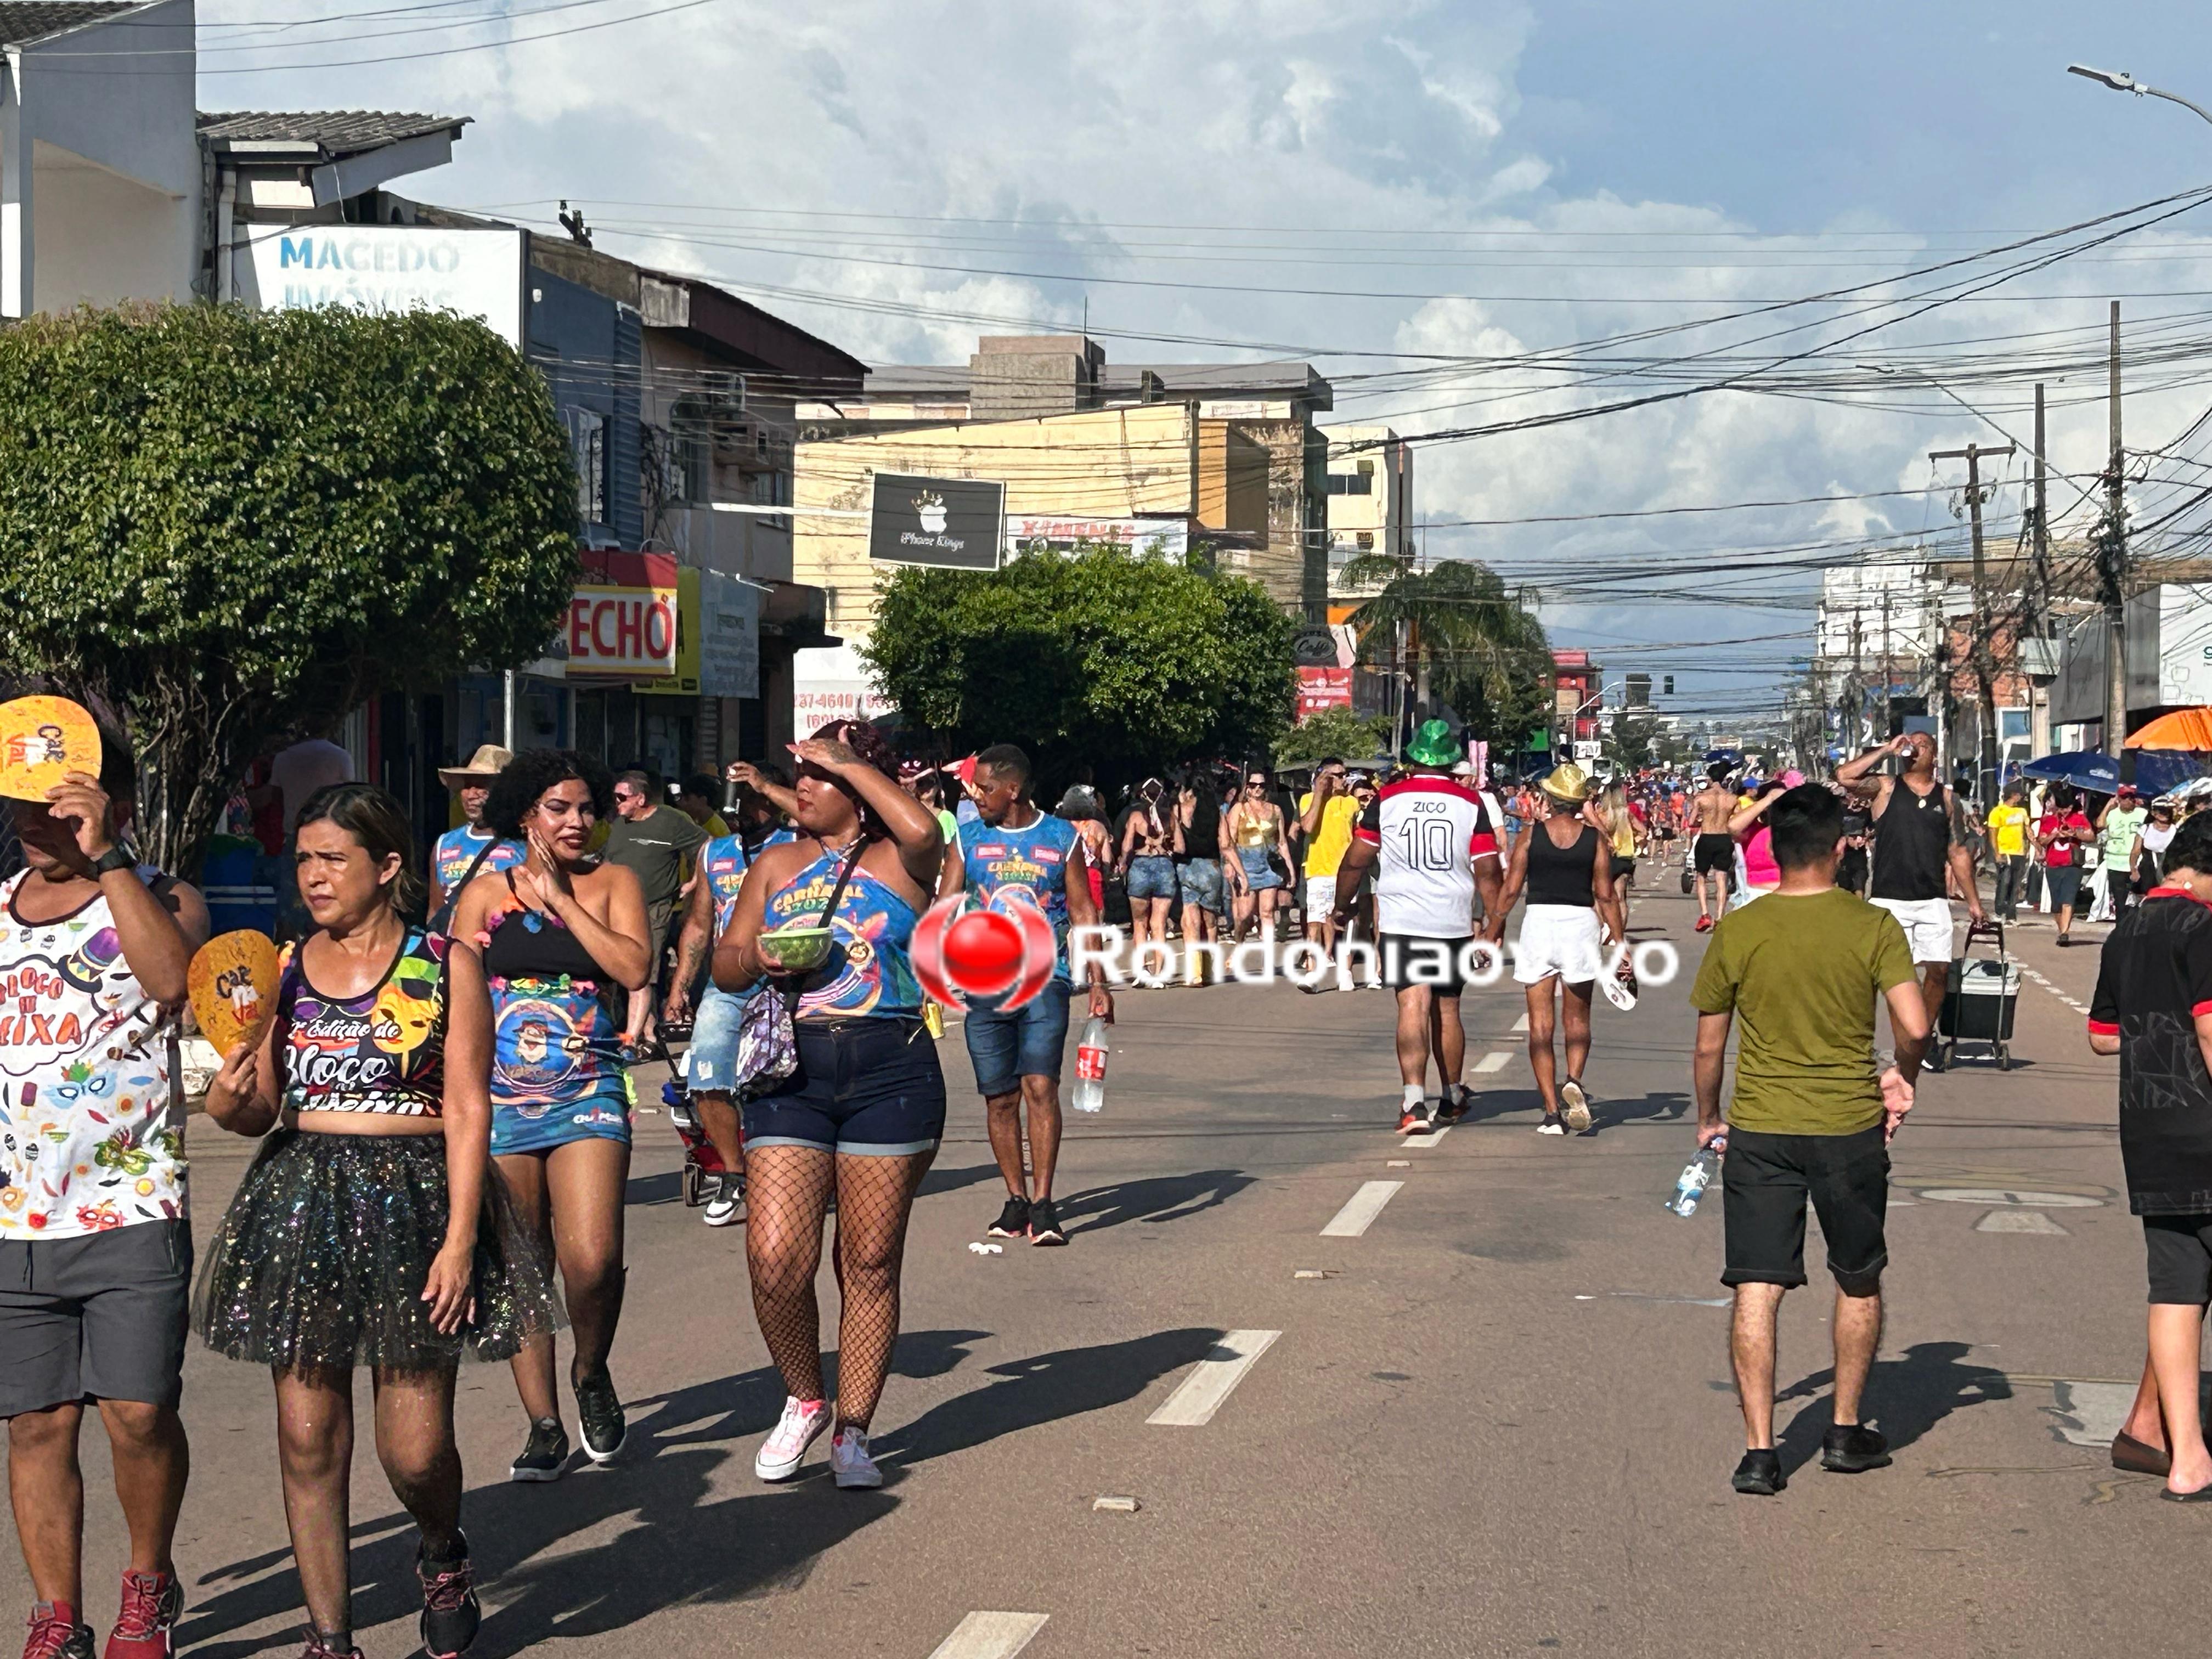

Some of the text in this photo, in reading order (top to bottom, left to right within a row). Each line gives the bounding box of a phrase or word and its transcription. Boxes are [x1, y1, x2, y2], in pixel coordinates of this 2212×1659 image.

[280, 236, 459, 273] MACEDO
[1413, 802, 1446, 813] ZICO
[1398, 817, 1454, 871] 10
[772, 883, 865, 913] CARNAAL
[307, 1019, 370, 1040] Edição
[374, 1020, 399, 1038] do
